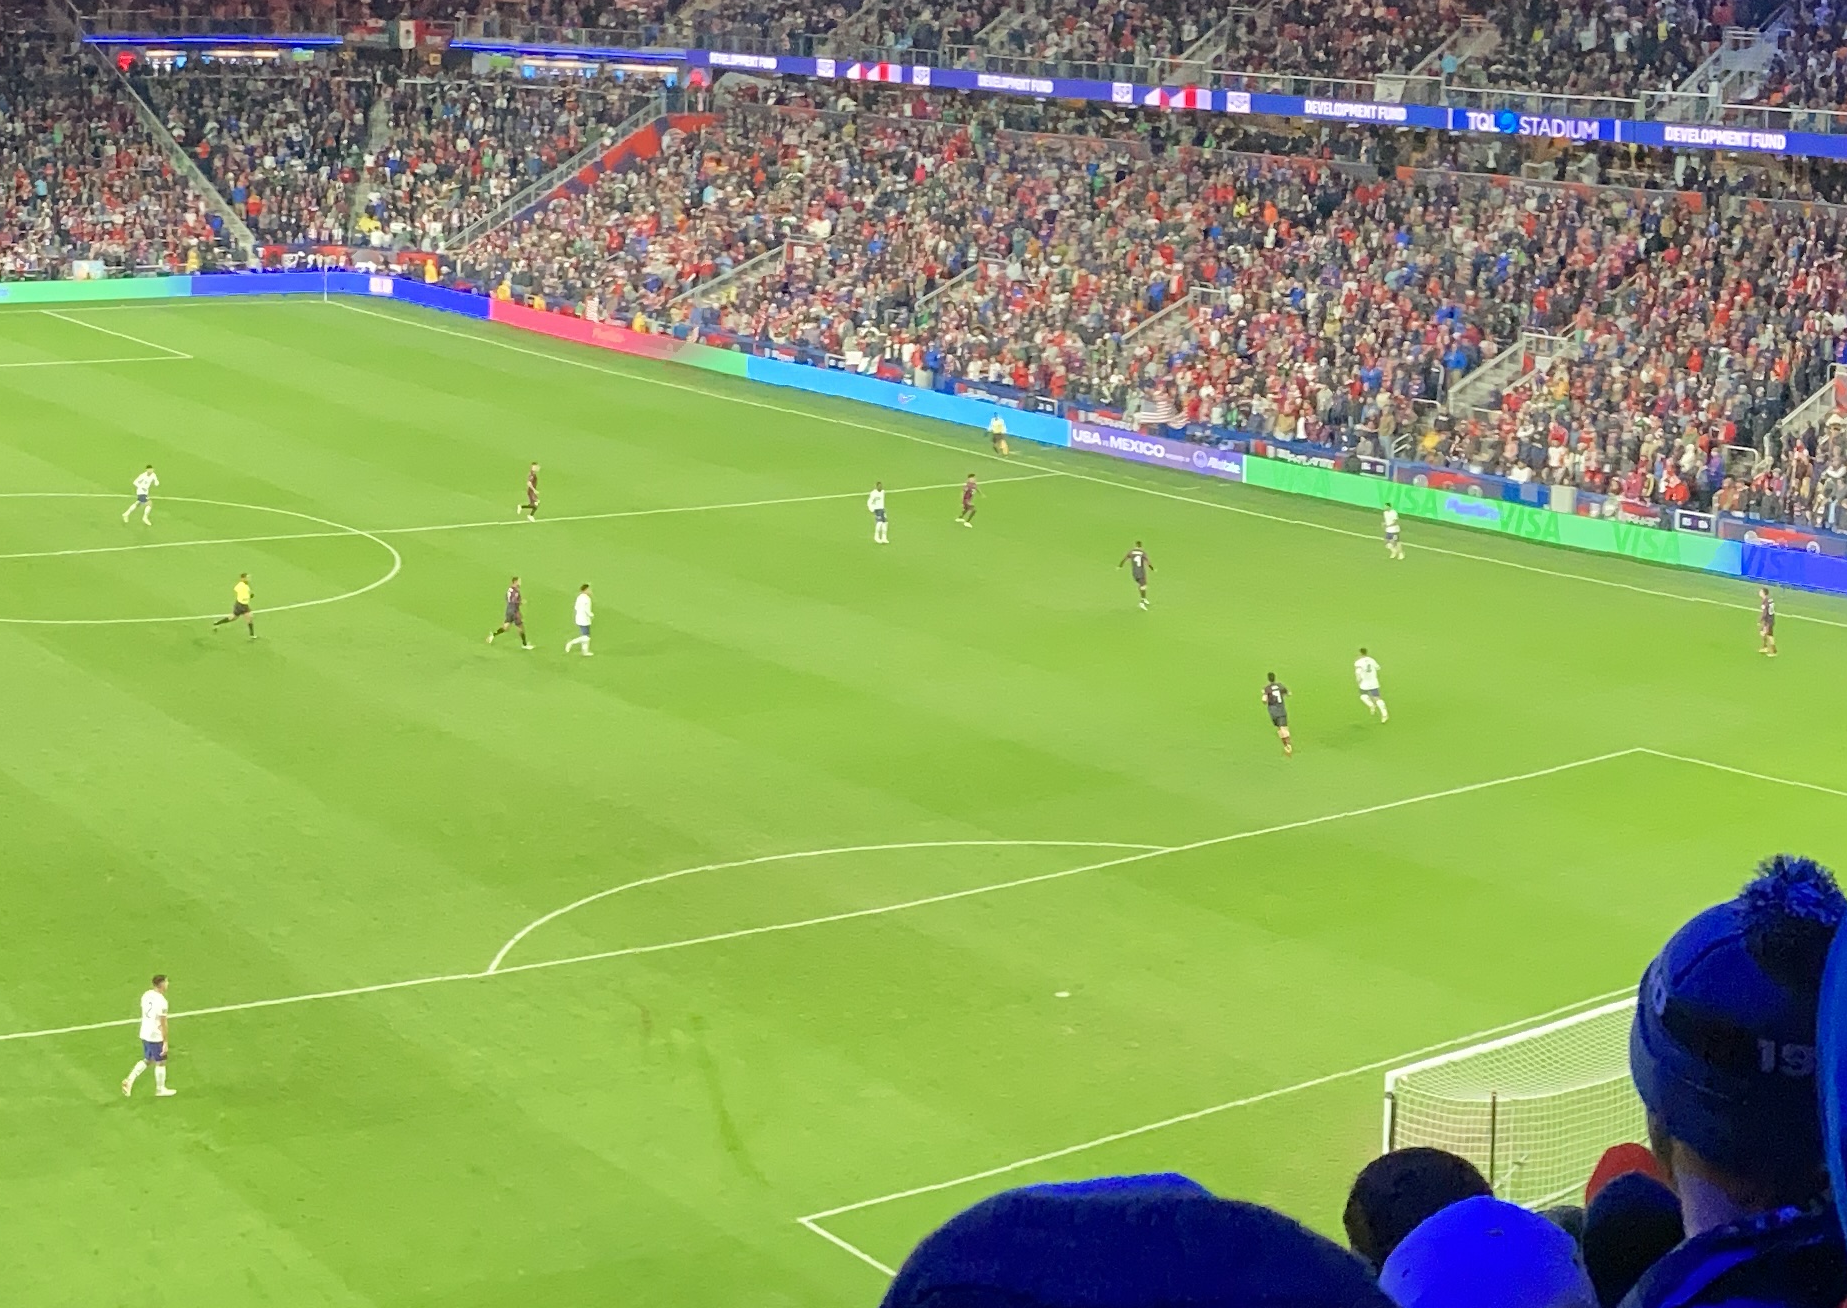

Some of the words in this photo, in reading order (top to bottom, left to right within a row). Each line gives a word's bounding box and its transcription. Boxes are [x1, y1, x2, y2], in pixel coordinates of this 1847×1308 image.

[1304, 99, 1376, 119] DEVELOPMENT
[1378, 107, 1407, 121] FUND
[1466, 112, 1500, 132] TQL
[1518, 116, 1600, 139] STADIUM
[1664, 126, 1750, 147] DEVELOPMENT
[1751, 132, 1786, 150] FUND
[1072, 428, 1103, 445] USA
[1110, 436, 1165, 458] MEXICO
[1207, 457, 1241, 474] Allstate
[1494, 501, 1562, 543] VISA
[1612, 522, 1682, 565] VISA
